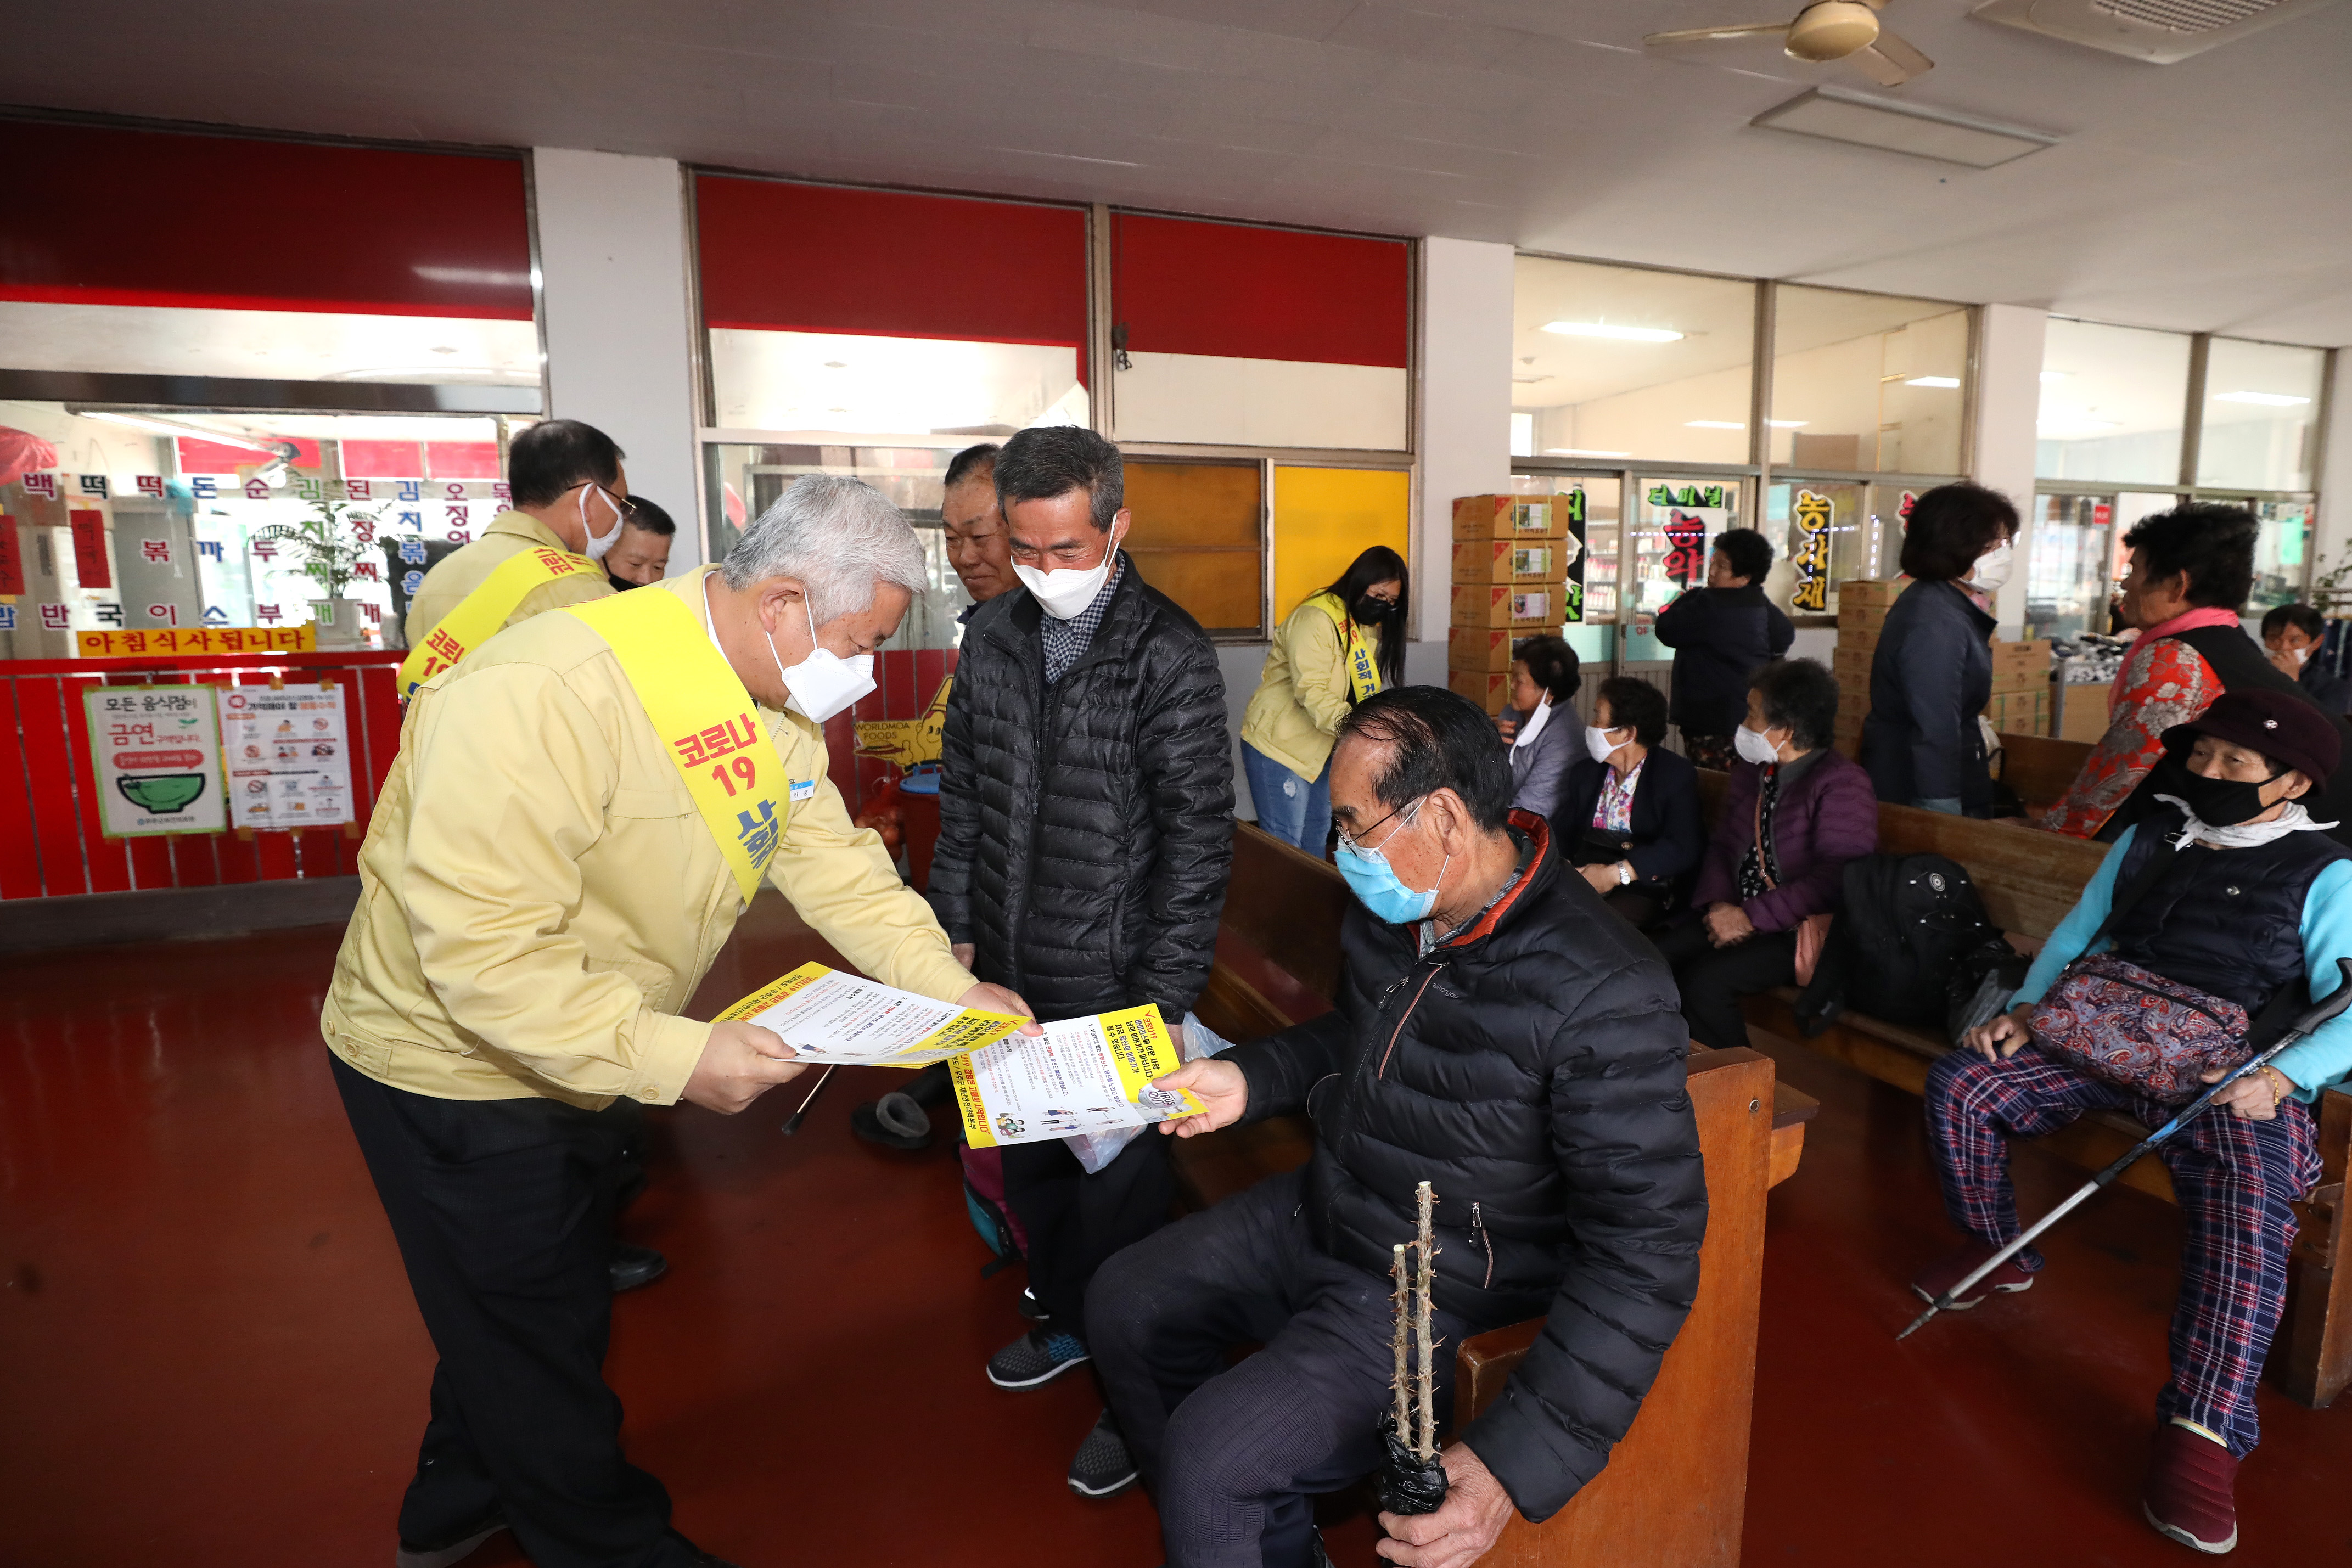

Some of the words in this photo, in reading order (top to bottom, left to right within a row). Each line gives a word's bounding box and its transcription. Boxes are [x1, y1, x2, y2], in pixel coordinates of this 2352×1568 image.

[1648, 484, 1722, 508] 터미널
[1793, 492, 1831, 611] 농자재
[1658, 508, 1705, 615] 농약
[85, 628, 306, 654] 아침식사됩니다
[104, 697, 137, 712] 모든
[108, 722, 155, 745] 금연
[855, 722, 910, 731] WORLDMOA
[674, 713, 757, 768] 코로나
[863, 732, 897, 740] FOODS
[711, 756, 756, 797] 19
[1433, 983, 1459, 998] allforyou
[988, 1022, 1011, 1035] 코로나19
[1125, 1021, 1136, 1031] 남의
[1134, 1019, 1150, 1044] 바이러스에
[1142, 1017, 1158, 1039] 코로나19
[1110, 1038, 1126, 1061] 있습니다.
[1114, 1024, 1124, 1034] 지금
[1119, 1035, 1131, 1050] 당신의
[1125, 1052, 1140, 1074] 이야기가
[1130, 1032, 1144, 1053] 이야기가
[1144, 1045, 1155, 1056] 의한
[951, 1056, 959, 1065] 북도
[959, 1054, 970, 1066] 나19
[1051, 1058, 1059, 1069] 당신도
[1138, 1054, 1154, 1080] 아닙니다.
[1149, 1057, 1161, 1070] 사망
[954, 1070, 965, 1086] 무주군
[964, 1068, 975, 1085] 감염은
[968, 1085, 980, 1103] 고통의
[1147, 1091, 1165, 1105] OUT
[1157, 1089, 1176, 1105] VIRUS
[958, 1086, 976, 1129] 재난안전대책본부
